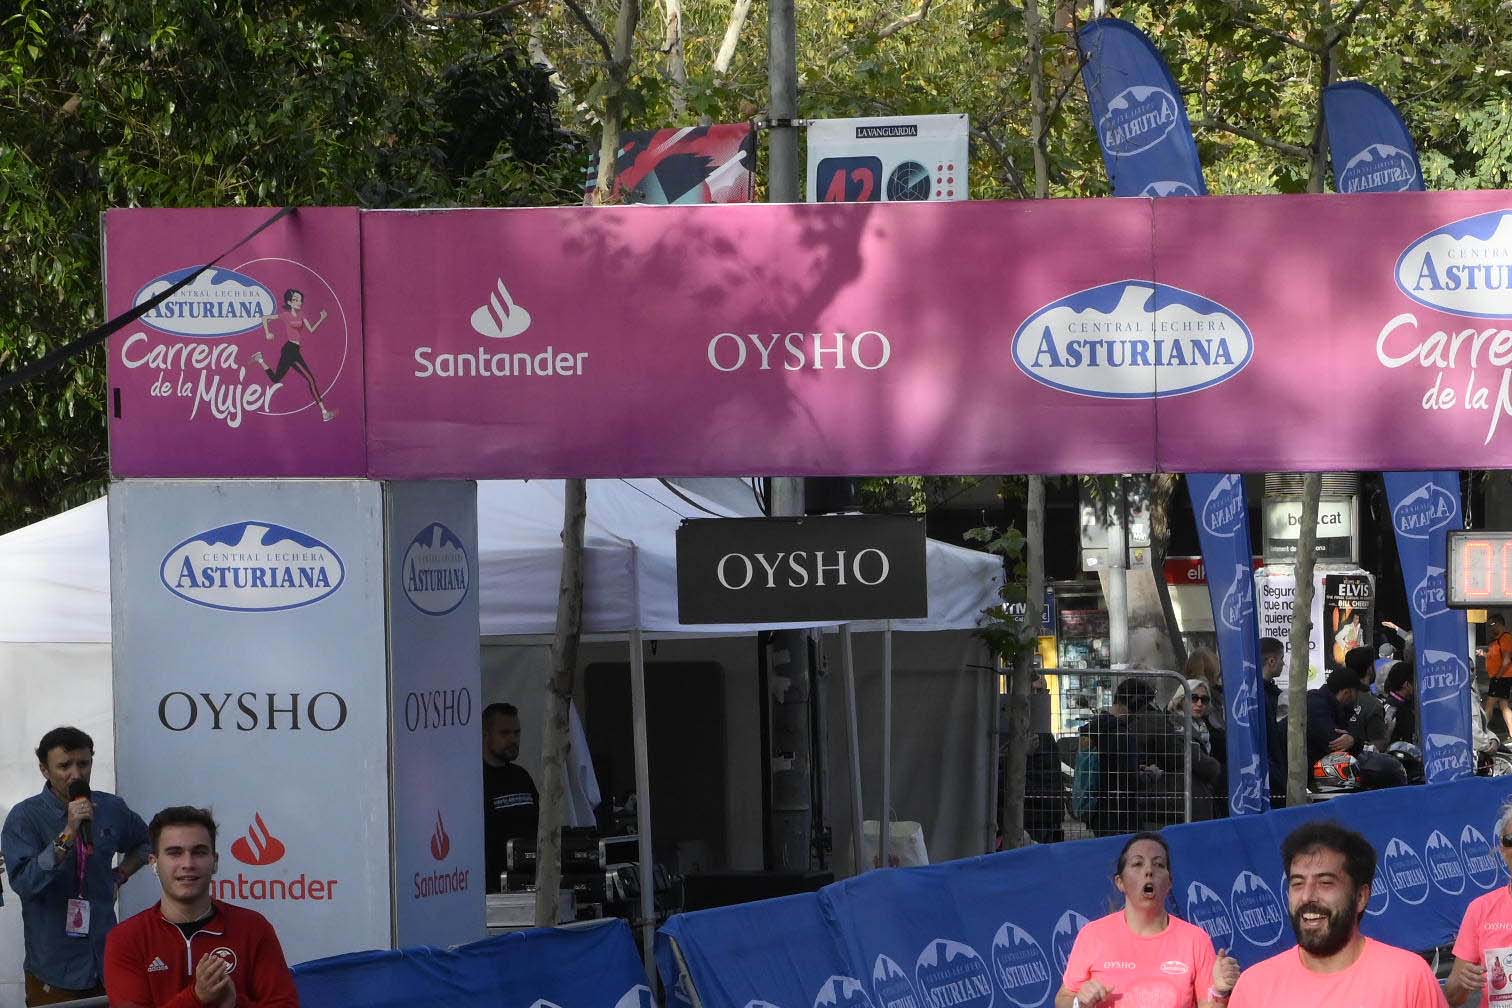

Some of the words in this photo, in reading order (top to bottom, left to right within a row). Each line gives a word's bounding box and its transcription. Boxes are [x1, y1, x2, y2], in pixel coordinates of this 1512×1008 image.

[867, 125, 917, 137] VANGUARDIA
[174, 290, 210, 298] ENTRAL
[214, 290, 261, 298] LECHERA
[1068, 321, 1147, 333] CENTRAL
[1152, 320, 1226, 332] LECHERA
[122, 332, 239, 370] Carrera
[414, 346, 588, 377] Santander
[708, 330, 891, 371] OYSHO
[1031, 325, 1234, 368] ASTURIANA
[151, 372, 172, 397] de
[178, 371, 193, 397] la
[189, 367, 283, 428] Mujer
[1422, 373, 1456, 410] de
[1464, 370, 1489, 410] la
[175, 555, 331, 588] ASTURIANA
[203, 553, 260, 562] CENTRAL
[266, 553, 325, 562] LECHERA
[717, 548, 890, 590] OYSHO
[408, 558, 465, 592] ASTURIANA
[1339, 584, 1369, 597] ELVIS
[1264, 602, 1280, 614] que
[158, 692, 348, 732] OYSHO
[405, 687, 472, 732] OYSHO
[414, 868, 470, 899] Santander
[1392, 866, 1428, 890] ASTURIANA
[999, 958, 1048, 989] ASTURIANA
